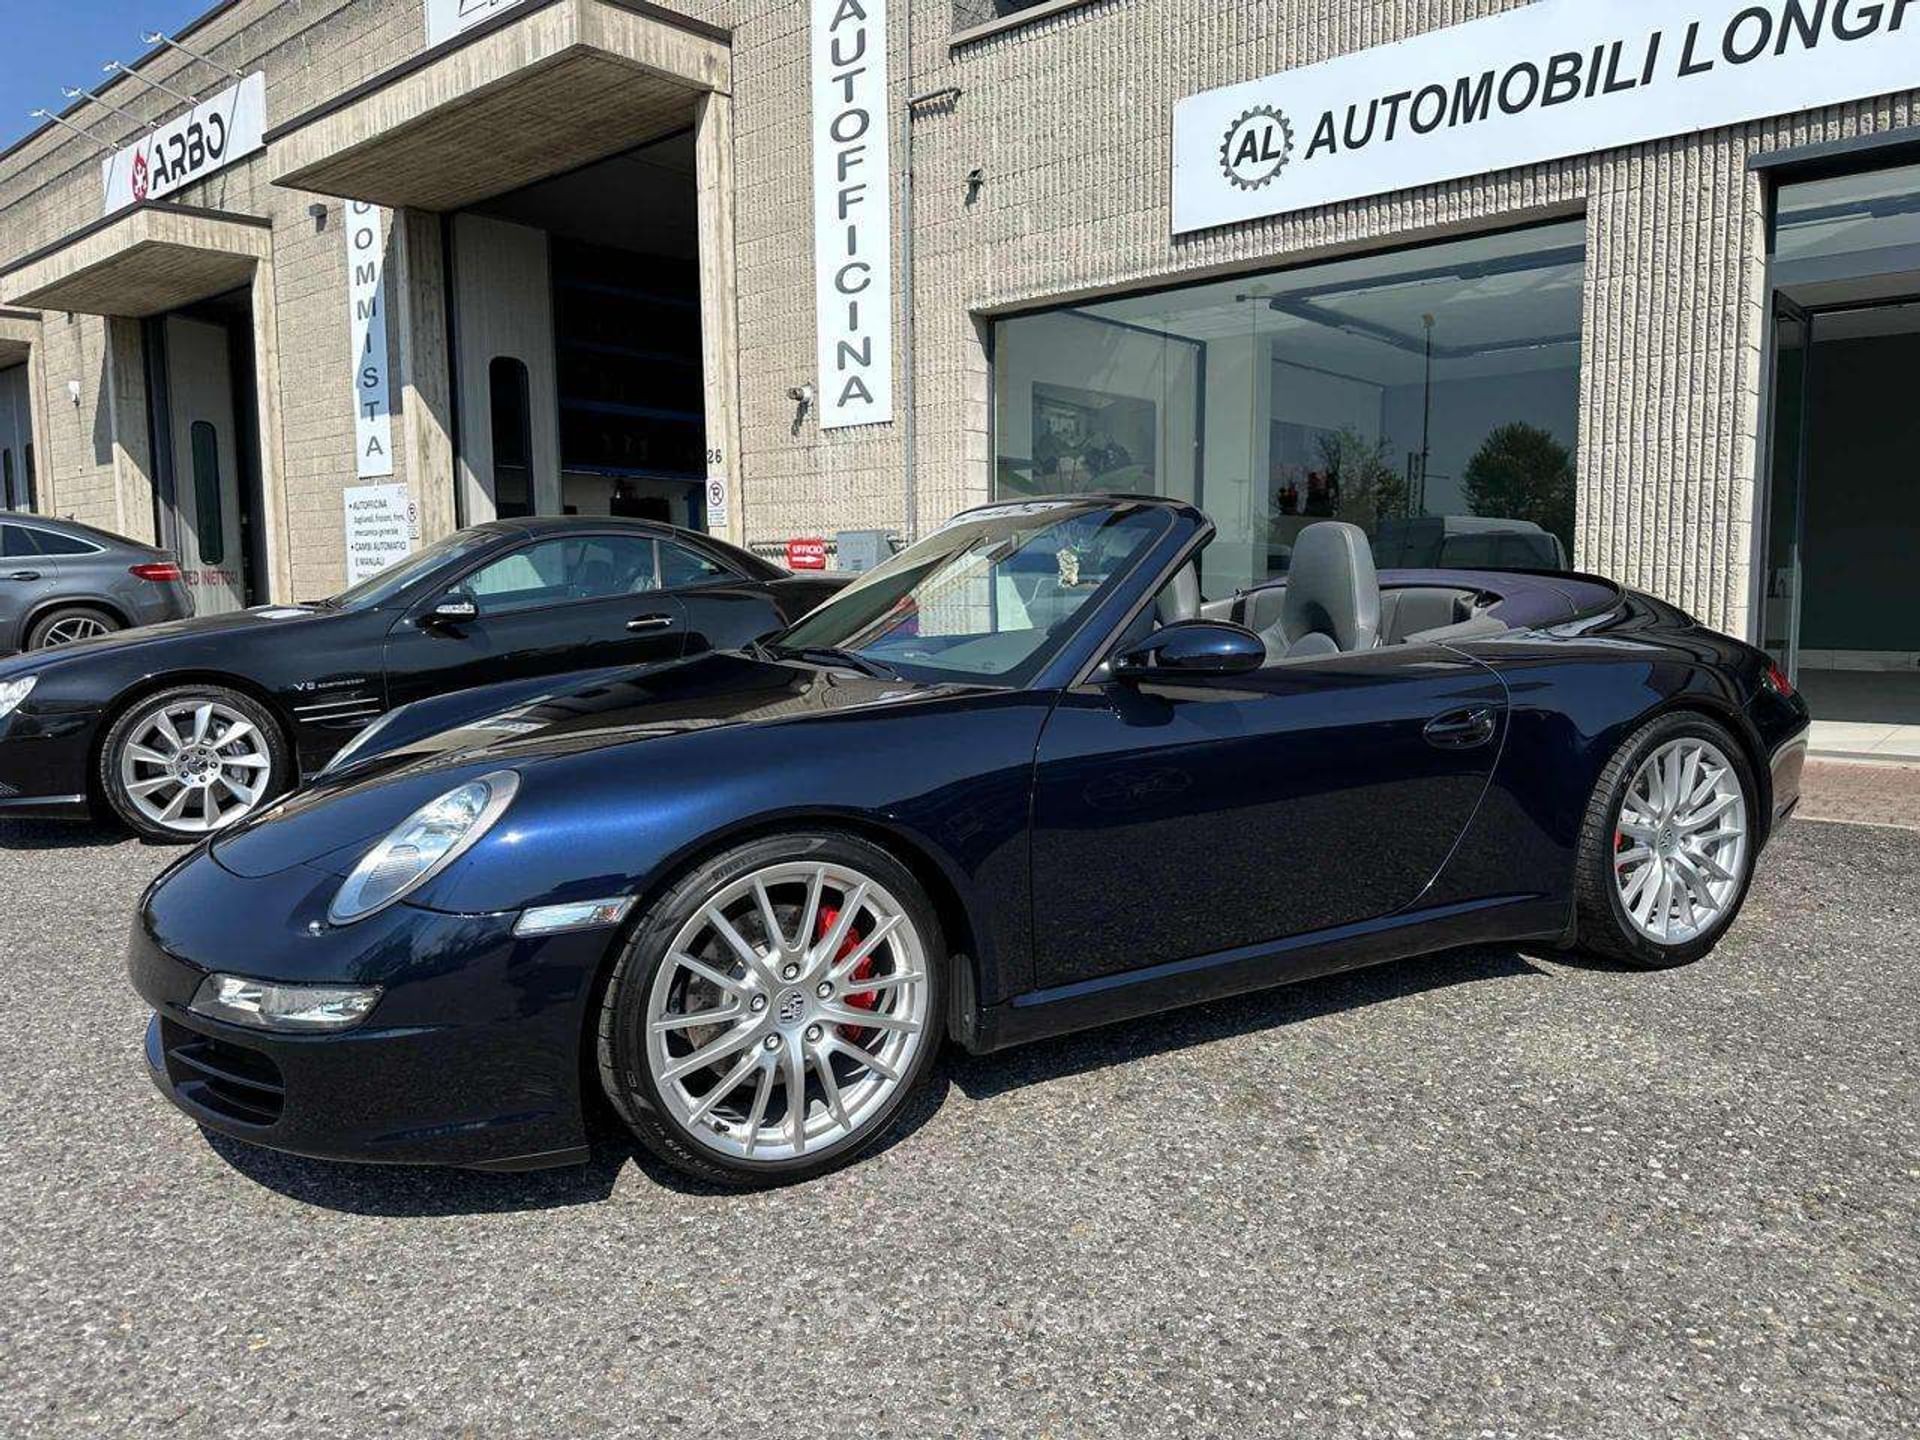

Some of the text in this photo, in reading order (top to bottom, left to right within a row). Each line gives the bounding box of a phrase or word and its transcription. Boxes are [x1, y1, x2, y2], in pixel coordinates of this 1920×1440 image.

[1304, 31, 1662, 160] AUTOMOBILI
[152, 112, 225, 190] ARBO
[1233, 125, 1281, 167] AL
[829, 0, 874, 408] AUTOFFICINA
[708, 449, 722, 464] 26
[792, 544, 822, 555] UFFICIO
